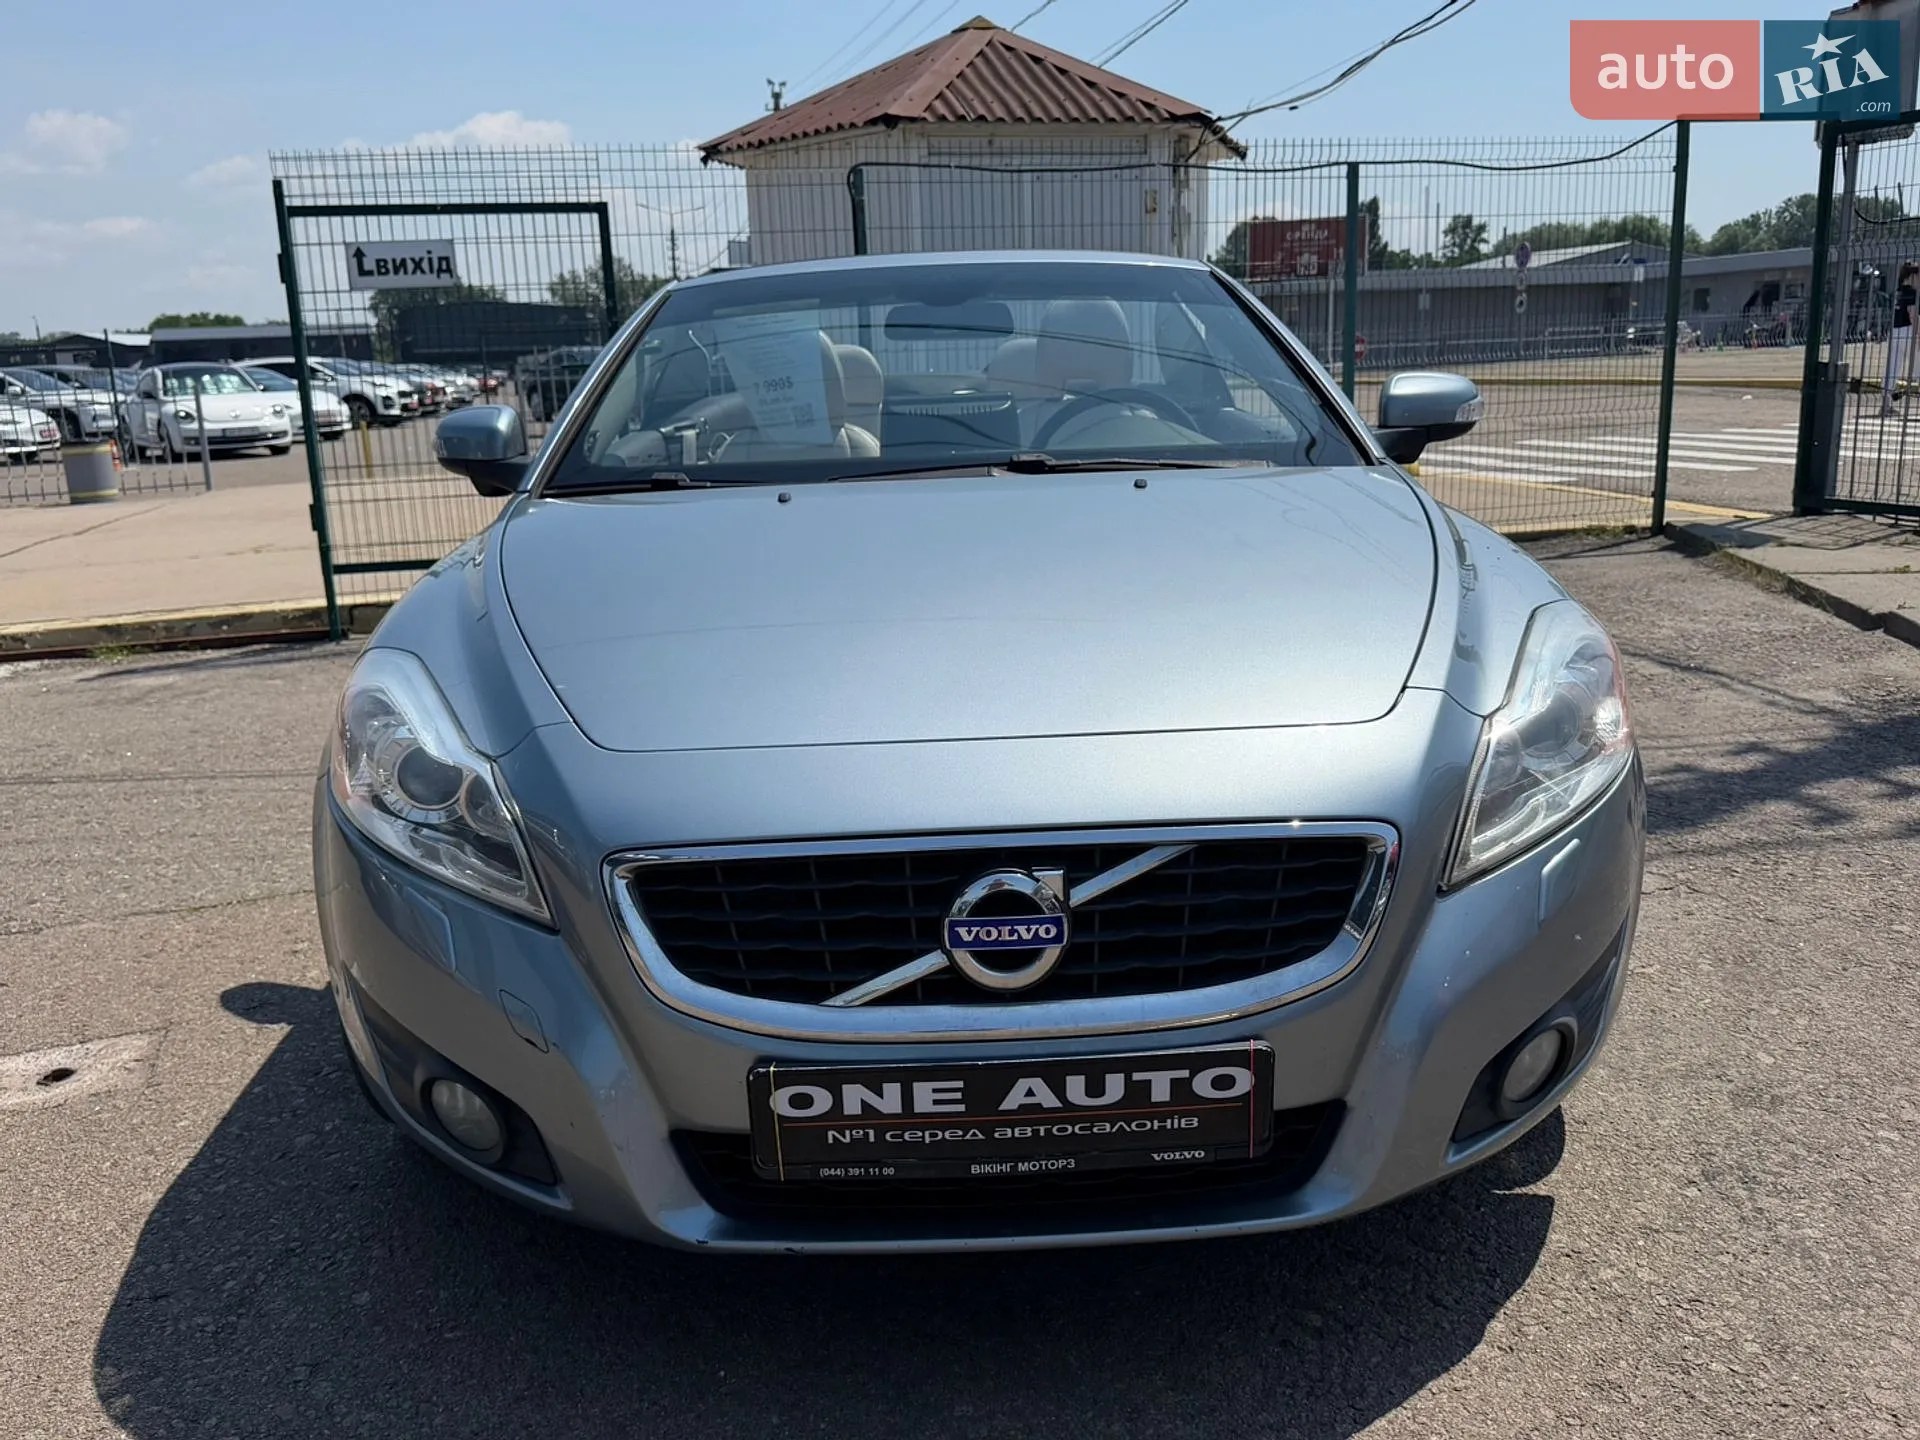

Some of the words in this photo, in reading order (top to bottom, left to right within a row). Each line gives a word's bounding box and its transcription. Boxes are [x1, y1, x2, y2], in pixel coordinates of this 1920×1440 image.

[375, 249, 454, 279] вихід
[954, 923, 1058, 942] VOLVO
[769, 1080, 966, 1118] ONE
[998, 1066, 1255, 1110] AUTO
[885, 1127, 985, 1144] серед
[993, 1115, 1199, 1139] автосалонів
[1151, 1150, 1206, 1162] VOLVO
[819, 1167, 846, 1178] (044)
[847, 1167, 865, 1176] 391
[868, 1166, 880, 1176] 11
[882, 1166, 895, 1176] 00
[970, 1161, 1015, 1174] ВІКІНГ
[1017, 1158, 1076, 1173] МОТОРЗ
